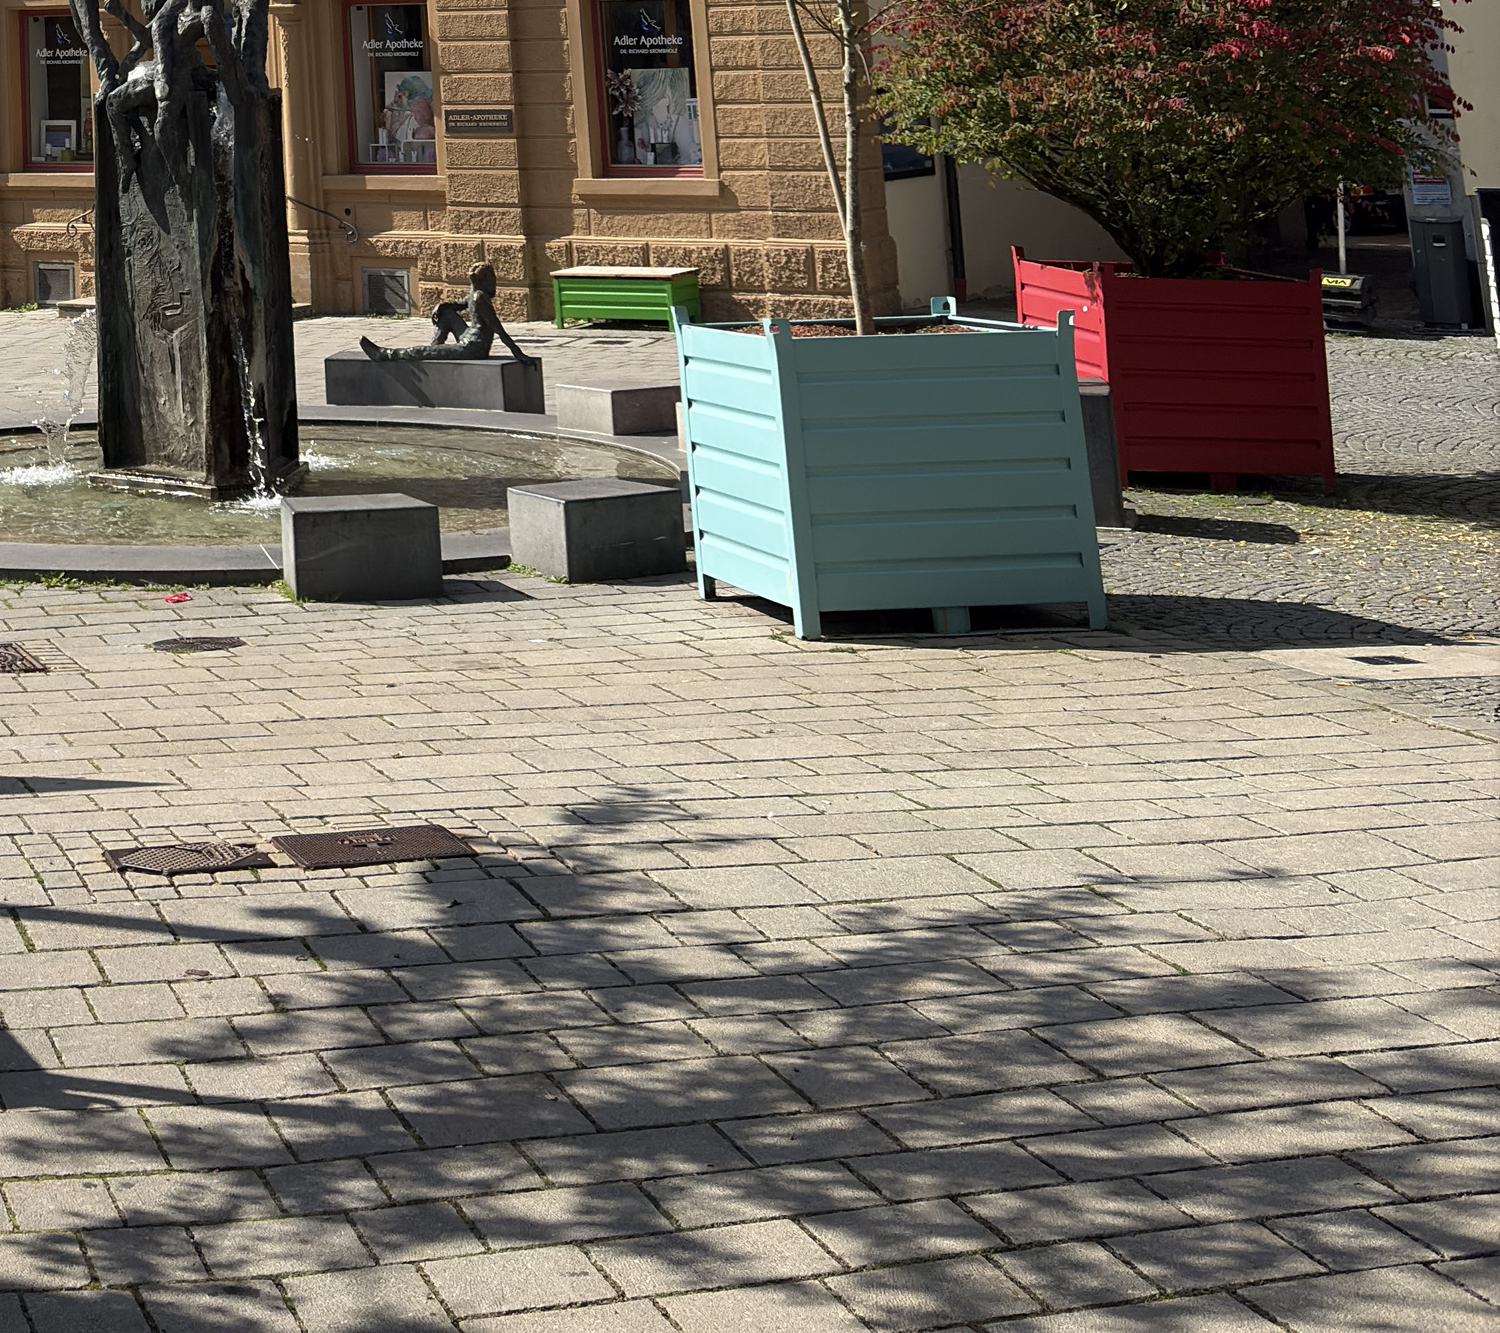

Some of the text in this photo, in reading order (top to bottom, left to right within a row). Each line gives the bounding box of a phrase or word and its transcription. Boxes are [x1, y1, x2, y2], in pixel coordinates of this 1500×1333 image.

[362, 38, 424, 51] Adler Apotheke
[613, 34, 683, 48] Adler Apotheke
[35, 47, 88, 59] Adler Apotheke
